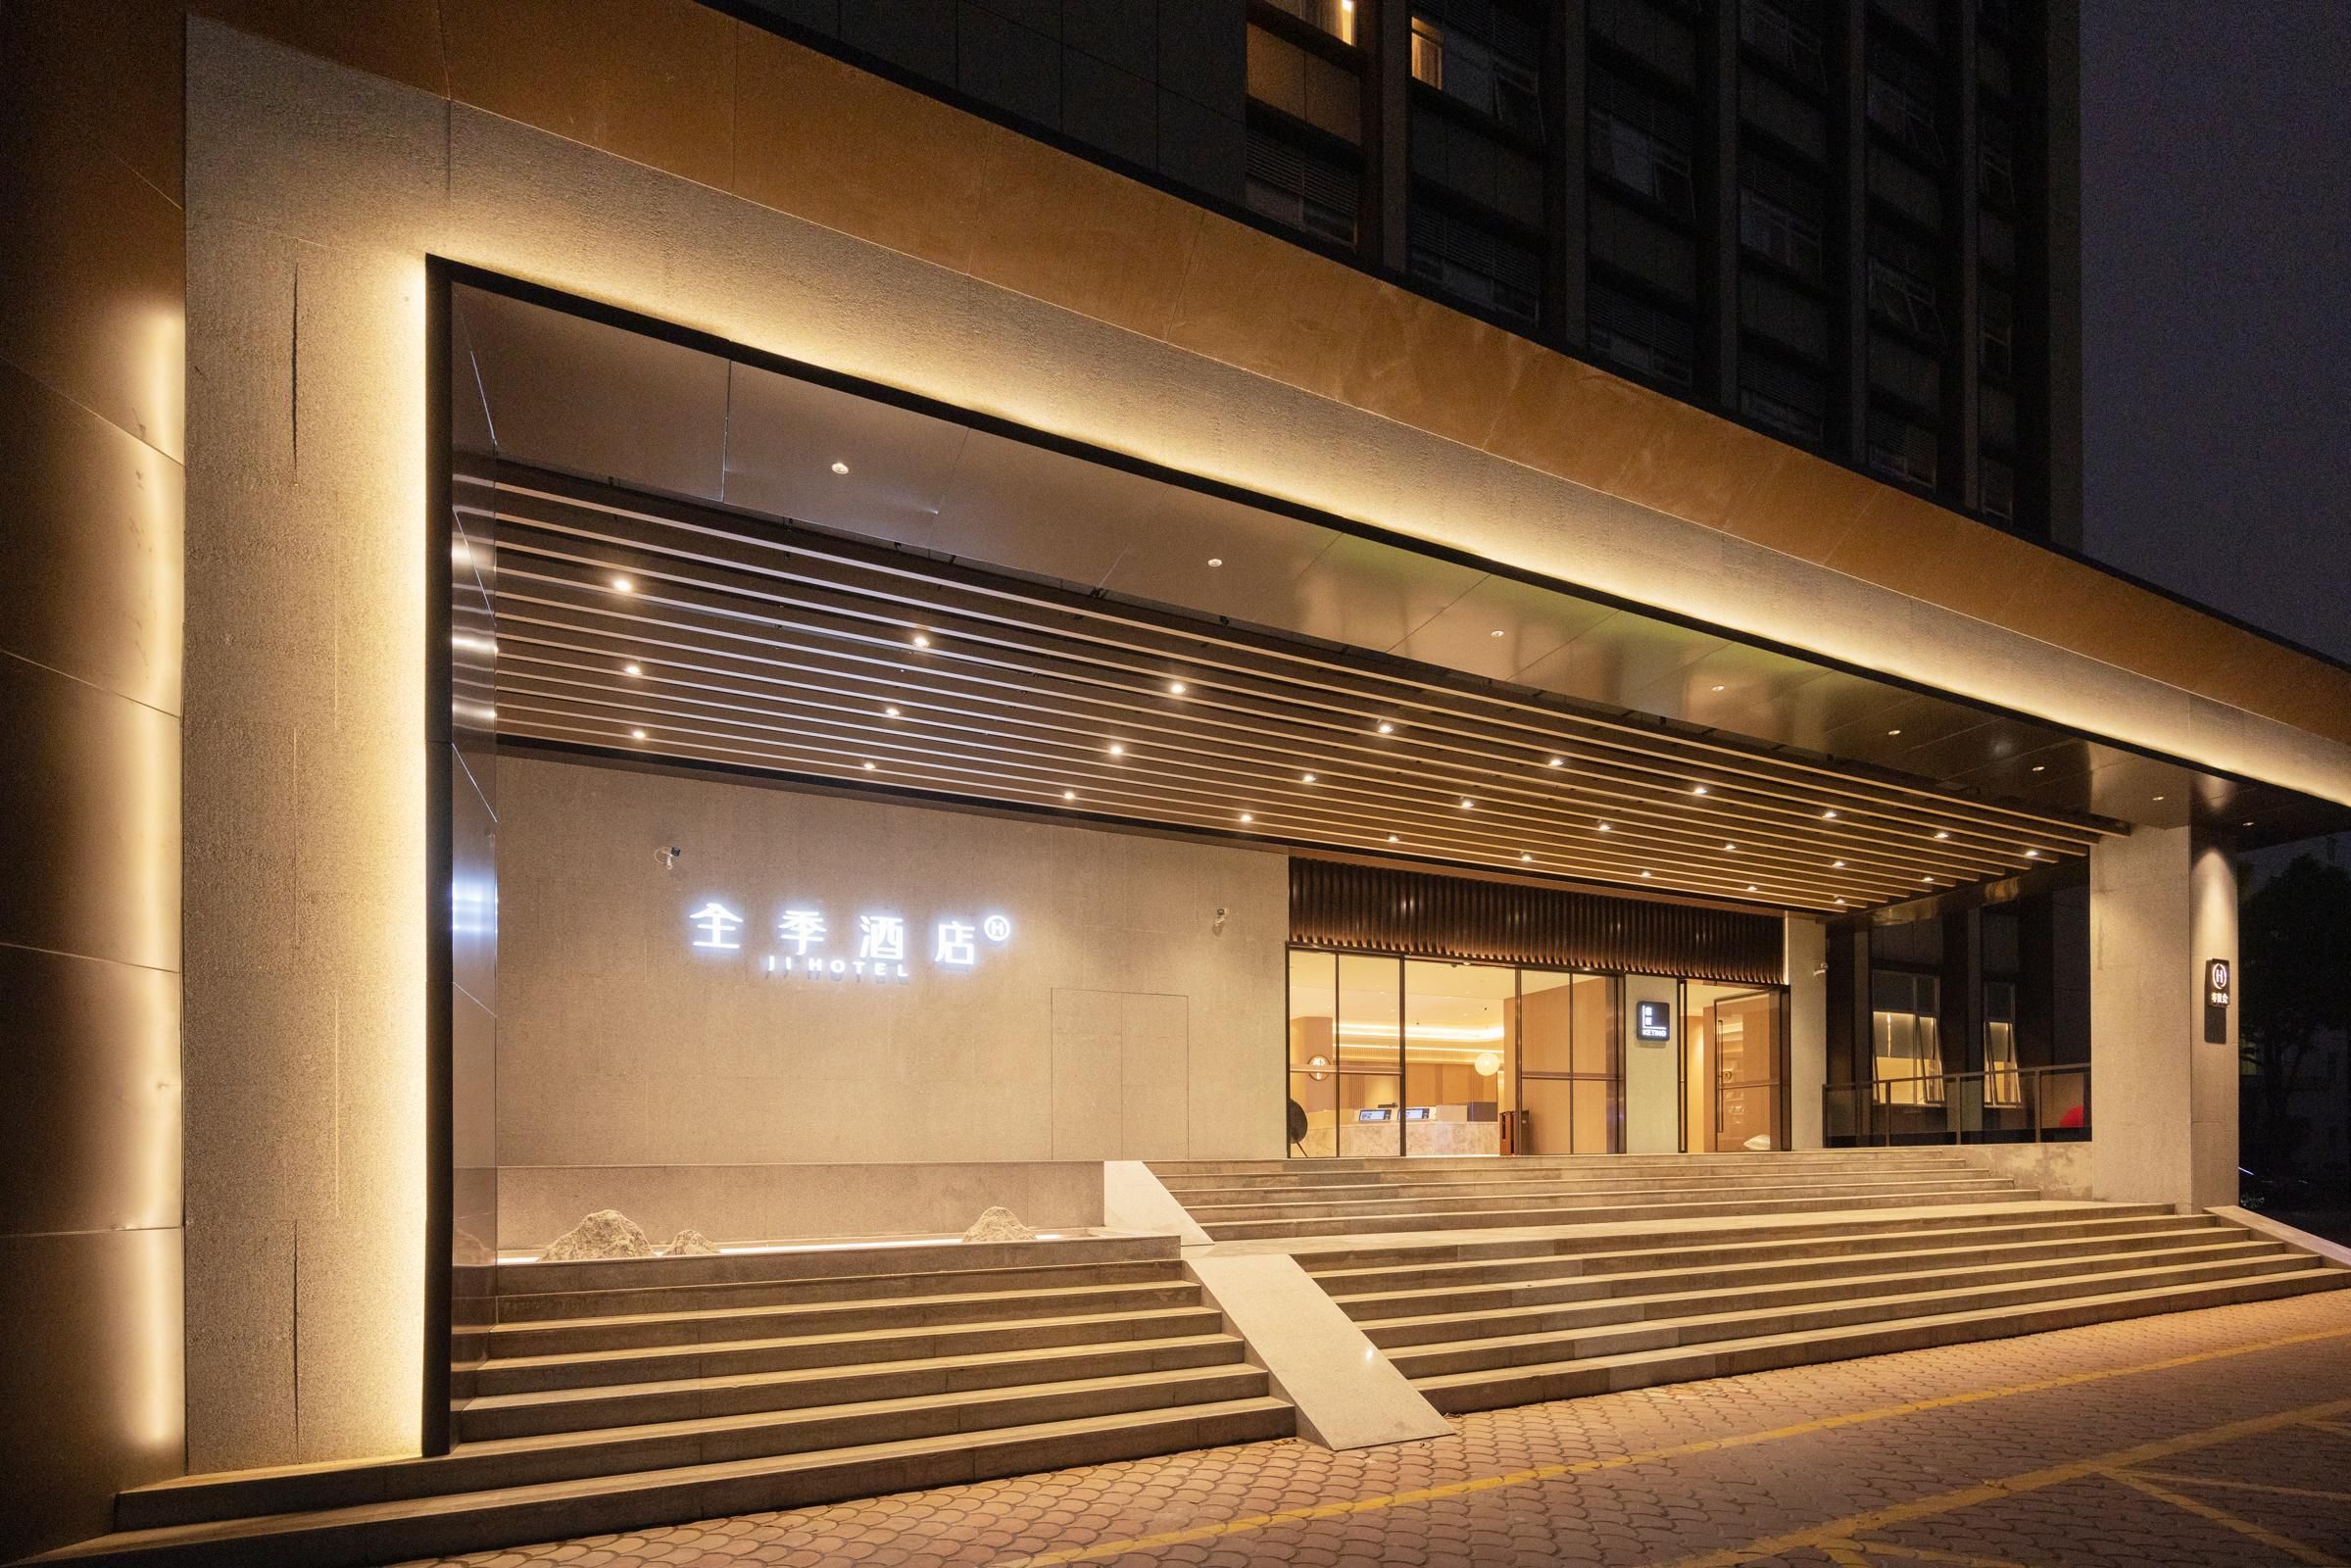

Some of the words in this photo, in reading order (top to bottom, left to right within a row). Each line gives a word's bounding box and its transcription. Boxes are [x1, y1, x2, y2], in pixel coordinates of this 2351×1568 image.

[690, 902, 975, 965] 全季酒店
[768, 956, 792, 972] JI
[808, 956, 909, 977] HOTEL
